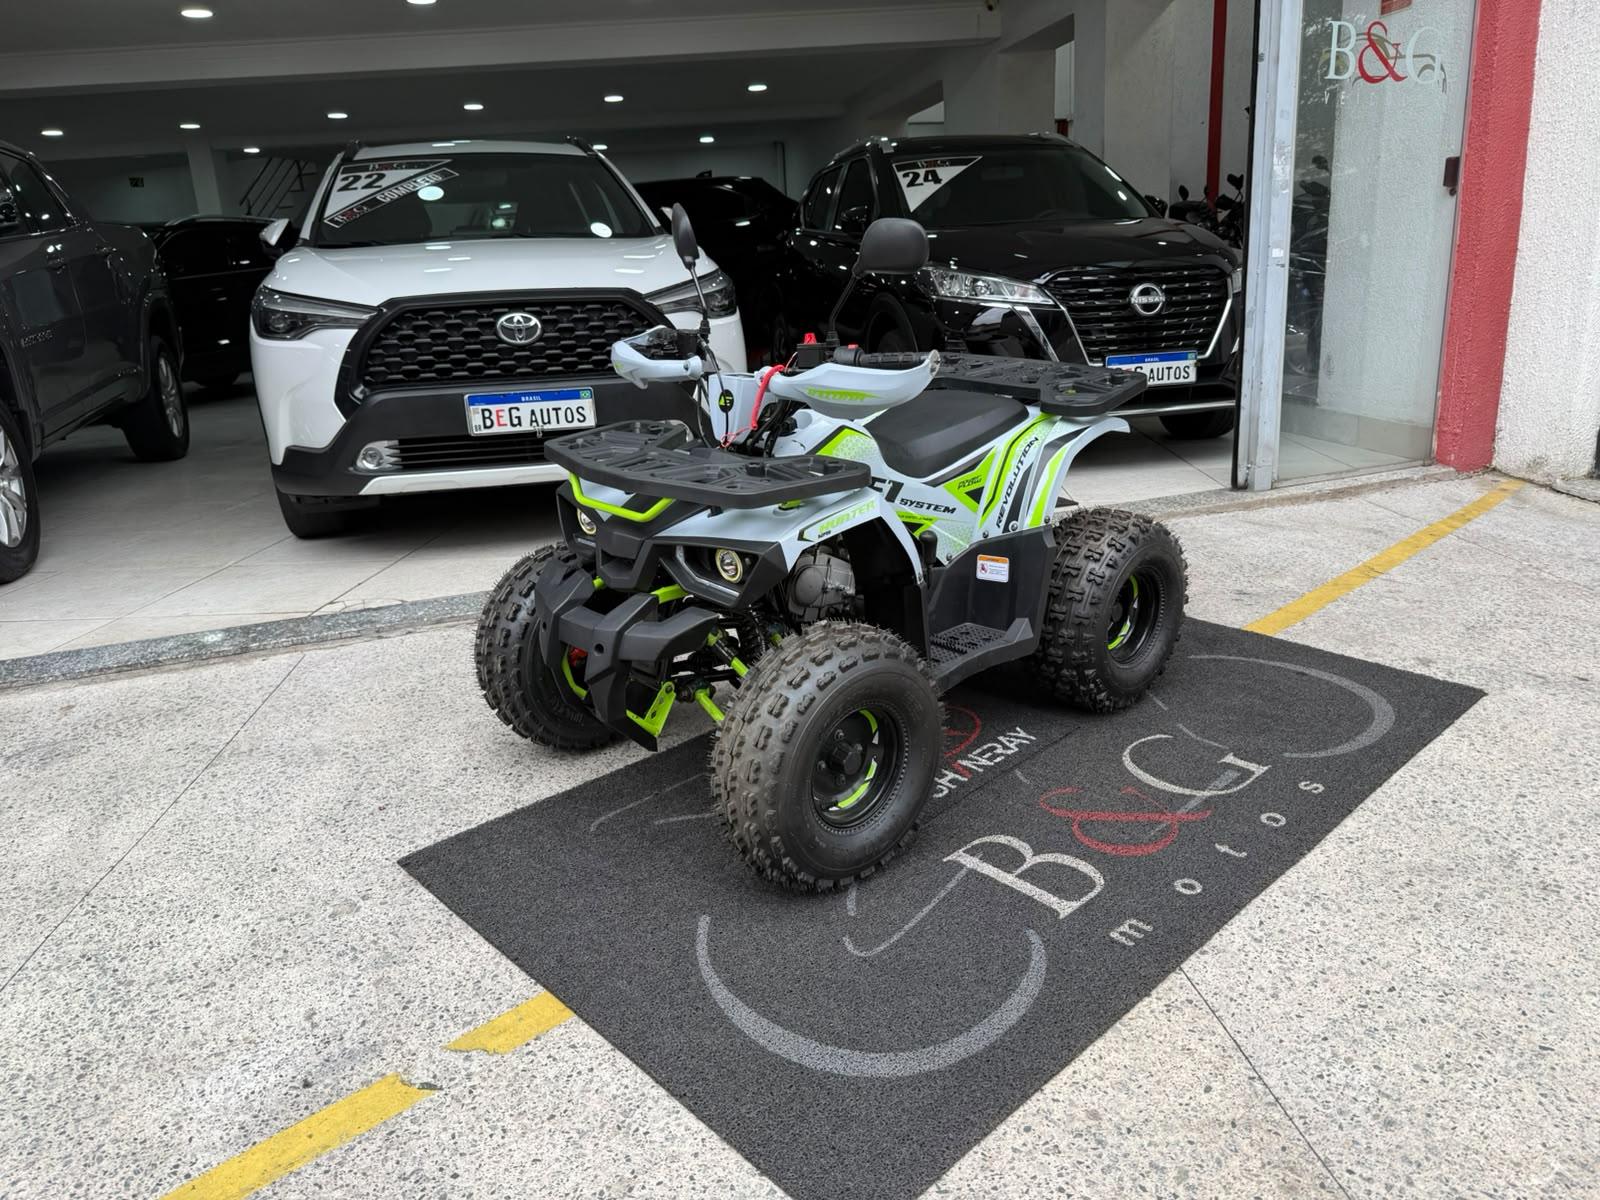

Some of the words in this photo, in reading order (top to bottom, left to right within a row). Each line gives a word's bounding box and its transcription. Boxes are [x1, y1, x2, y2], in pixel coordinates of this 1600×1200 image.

[337, 173, 386, 192] 22
[902, 169, 943, 188] 24
[1130, 292, 1166, 304] NISSAN
[1148, 365, 1190, 383] AUTOS
[529, 405, 587, 428] AUTOS
[996, 436, 1039, 529] REVOLUTION
[899, 498, 957, 514] SYSTEM
[1110, 780, 1326, 946] motos
